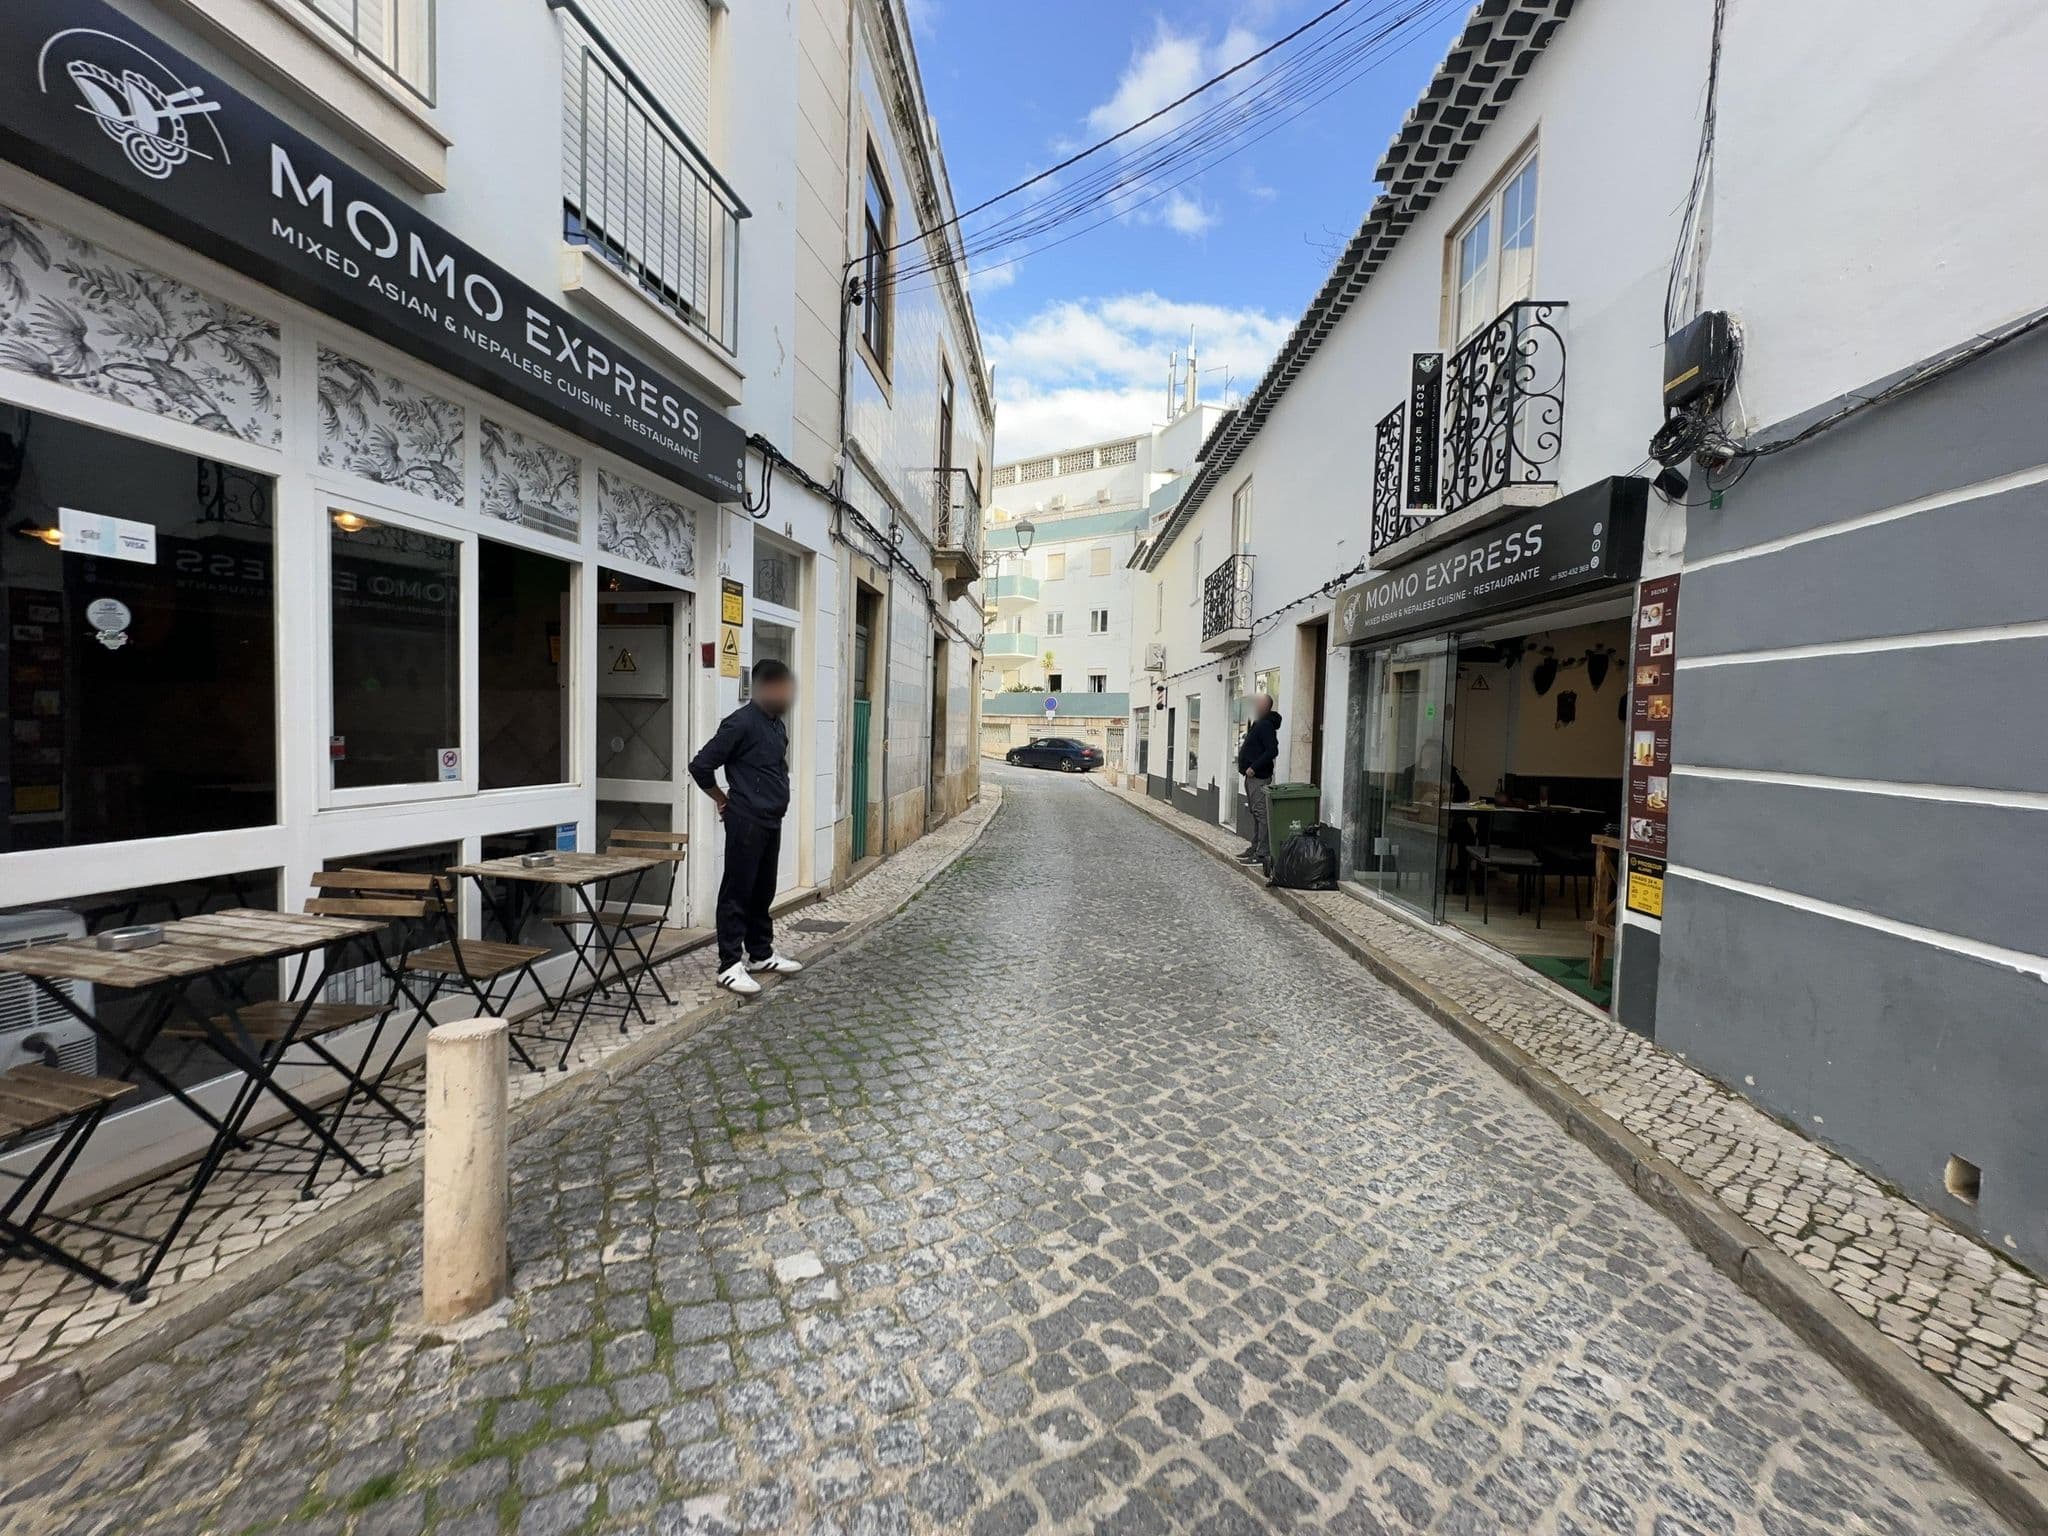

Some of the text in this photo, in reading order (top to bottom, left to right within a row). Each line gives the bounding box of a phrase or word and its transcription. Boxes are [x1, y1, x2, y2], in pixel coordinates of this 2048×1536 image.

[271, 143, 699, 441] MOMO EXPRESS
[271, 218, 361, 278] MIXED
[367, 274, 437, 323] ASIAN
[444, 315, 457, 333] &
[463, 325, 553, 384] NEPALESE
[557, 378, 613, 417] CUISINE
[623, 414, 699, 464] RESTAURANTE
[1413, 384, 1425, 493] MOMO EXPRESS
[1365, 524, 1543, 612] MOMO EXPRESS
[1381, 612, 1398, 623] ASIAN
[1403, 598, 1436, 616] NEPALESE
[1436, 589, 1467, 607] CUISINE
[1473, 566, 1541, 596] RESTAURANTE
